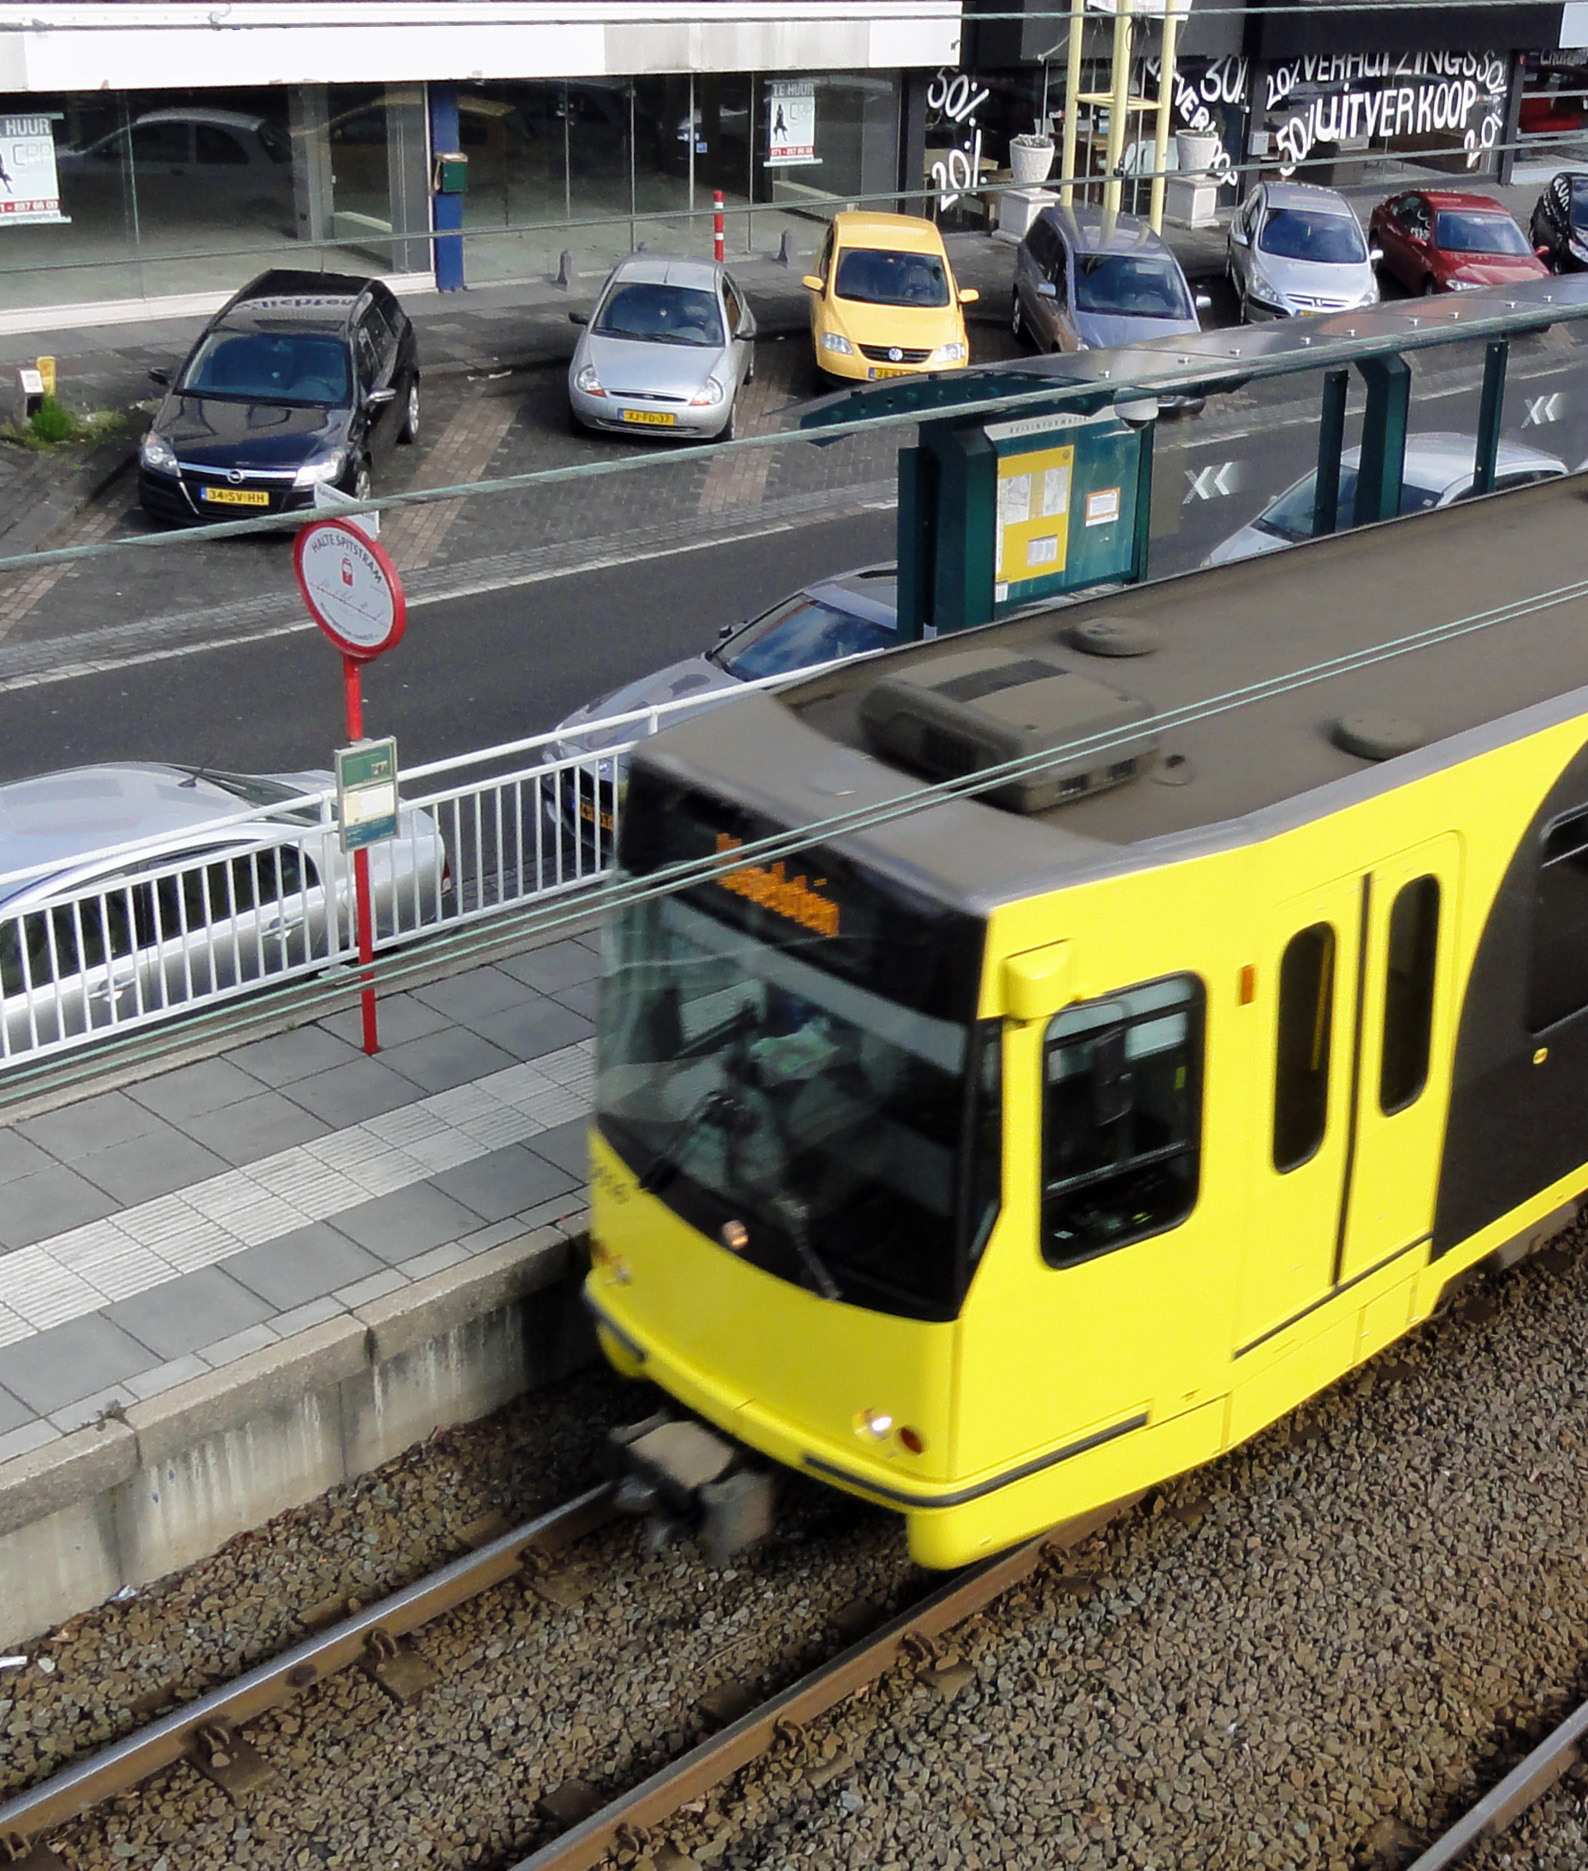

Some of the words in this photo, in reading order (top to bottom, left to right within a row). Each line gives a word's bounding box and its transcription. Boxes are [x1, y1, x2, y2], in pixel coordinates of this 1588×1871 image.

[787, 83, 815, 96] HUUR
[5, 118, 51, 136] HUUR
[311, 533, 337, 553] HALTE
[335, 535, 383, 585] SPITSTRAM
